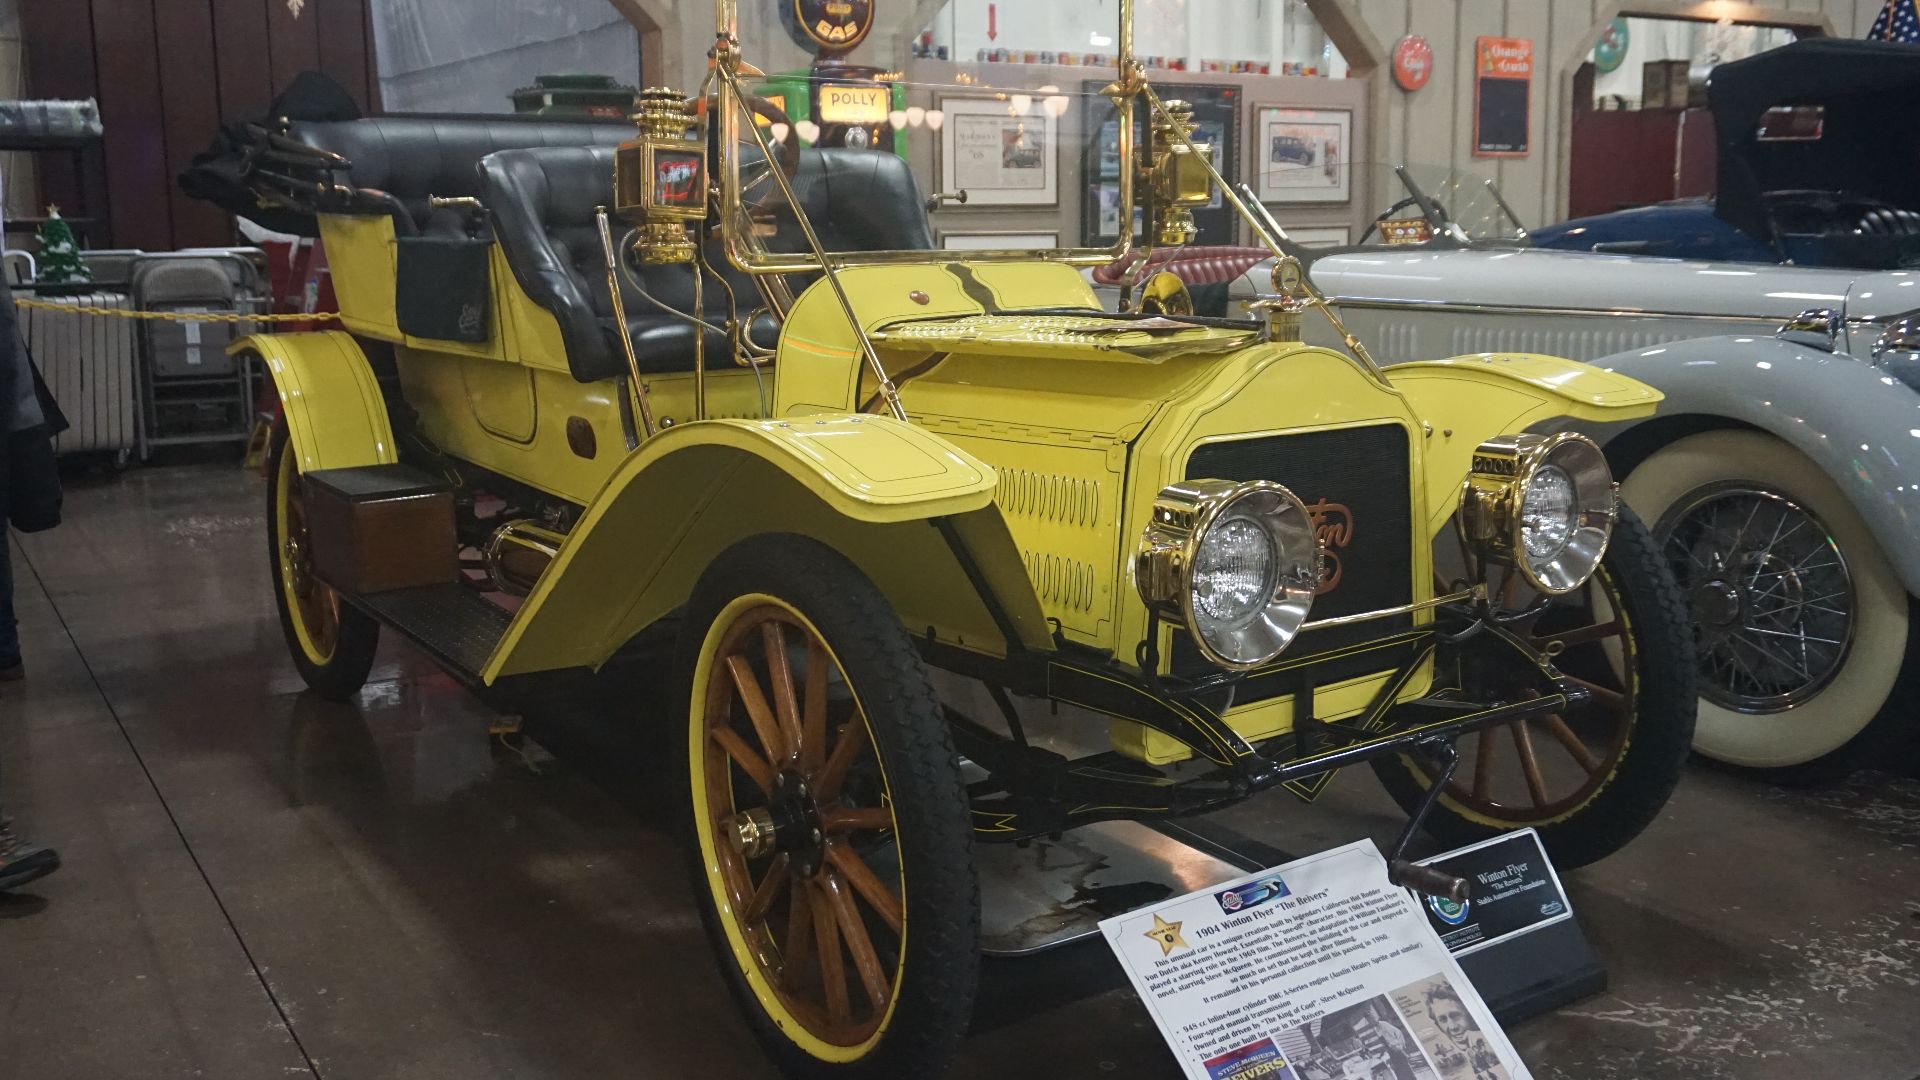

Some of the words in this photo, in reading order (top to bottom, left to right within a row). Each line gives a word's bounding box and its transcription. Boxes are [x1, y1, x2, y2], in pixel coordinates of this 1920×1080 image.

[816, 20, 858, 40] GAS
[831, 93, 877, 107] POLLY
[1478, 868, 1507, 884] Winton
[1507, 862, 1529, 876] Flyer
[1143, 972, 1158, 981] Von
[1158, 965, 1179, 977] Dutch
[1179, 961, 1193, 970] aka
[1191, 954, 1213, 965] Kenny
[1212, 944, 1240, 958] Howard.
[1239, 933, 1273, 949] Essentially
[1347, 902, 1364, 912] 1904
[1363, 896, 1385, 906] Winton
[1383, 891, 1398, 900] Flyer
[1153, 958, 1169, 967] This
[1169, 948, 1196, 963] unusual
[1196, 945, 1207, 953] car
[1221, 934, 1243, 945] unique
[1243, 924, 1270, 938] creation
[1268, 919, 1285, 929] built
[1291, 908, 1321, 921] legendary
[1320, 898, 1350, 911] California
[1195, 924, 1220, 938] 1904
[1219, 915, 1253, 930] Winton
[1251, 907, 1274, 920] Flyer
[1148, 977, 1172, 992] played
[1177, 966, 1206, 980] starring
[1204, 962, 1218, 971] role
[1226, 956, 1238, 964] the
[1238, 948, 1256, 959] 1969
[1255, 944, 1272, 953] film,
[1270, 940, 1284, 948] The
[1348, 914, 1355, 922] of
[1354, 909, 1376, 919] William
[1156, 986, 1177, 999] novel,
[1177, 977, 1205, 991] starring
[1204, 971, 1222, 981] Steve
[1222, 961, 1254, 975] McQueen.
[1264, 941, 1307, 961] commissioned
[1306, 938, 1317, 946] the
[1316, 929, 1343, 942] building
[1341, 926, 1349, 934] of
[1359, 920, 1369, 928] car
[1369, 915, 1381, 924] and
[1209, 984, 1241, 1001] remained
[1247, 979, 1260, 987] his
[1259, 968, 1287, 984] personal
[1287, 959, 1317, 973] collection
[1316, 952, 1331, 963] until
[1330, 950, 1342, 958] his
[1341, 941, 1366, 956] passing
[1238, 969, 1257, 980] much
[1257, 966, 1267, 974] on
[1266, 961, 1277, 970] set
[1276, 957, 1290, 967] that
[1298, 949, 1314, 959] kept
[1319, 943, 1333, 952] after
[1242, 997, 1267, 1011] cylinder
[1308, 975, 1329, 986] engine
[1370, 954, 1388, 964] Sprite
[1388, 948, 1400, 958] and
[1187, 1023, 1225, 1042] Four-speed
[1225, 1013, 1250, 1028] manual
[1249, 1000, 1291, 1019] transmission
[1193, 1037, 1217, 1051] Owned
[1217, 1032, 1231, 1042] and
[1230, 1025, 1252, 1037] driven
[1276, 1009, 1294, 1020] King
[1292, 1006, 1300, 1014] of
[1319, 993, 1337, 1003] Steve
[1336, 983, 1364, 997] McQueen
[1198, 1051, 1212, 1060] The
[1213, 1045, 1227, 1055] only
[1228, 1040, 1241, 1049] one
[1240, 1033, 1257, 1044] built
[1256, 1030, 1267, 1038] for
[1268, 1025, 1281, 1034] use
[1287, 1018, 1301, 1026] The
[1300, 1009, 1325, 1021] Reivers
[1217, 1062, 1240, 1076] STEVE
[1221, 1057, 1286, 1080] EIVERS
